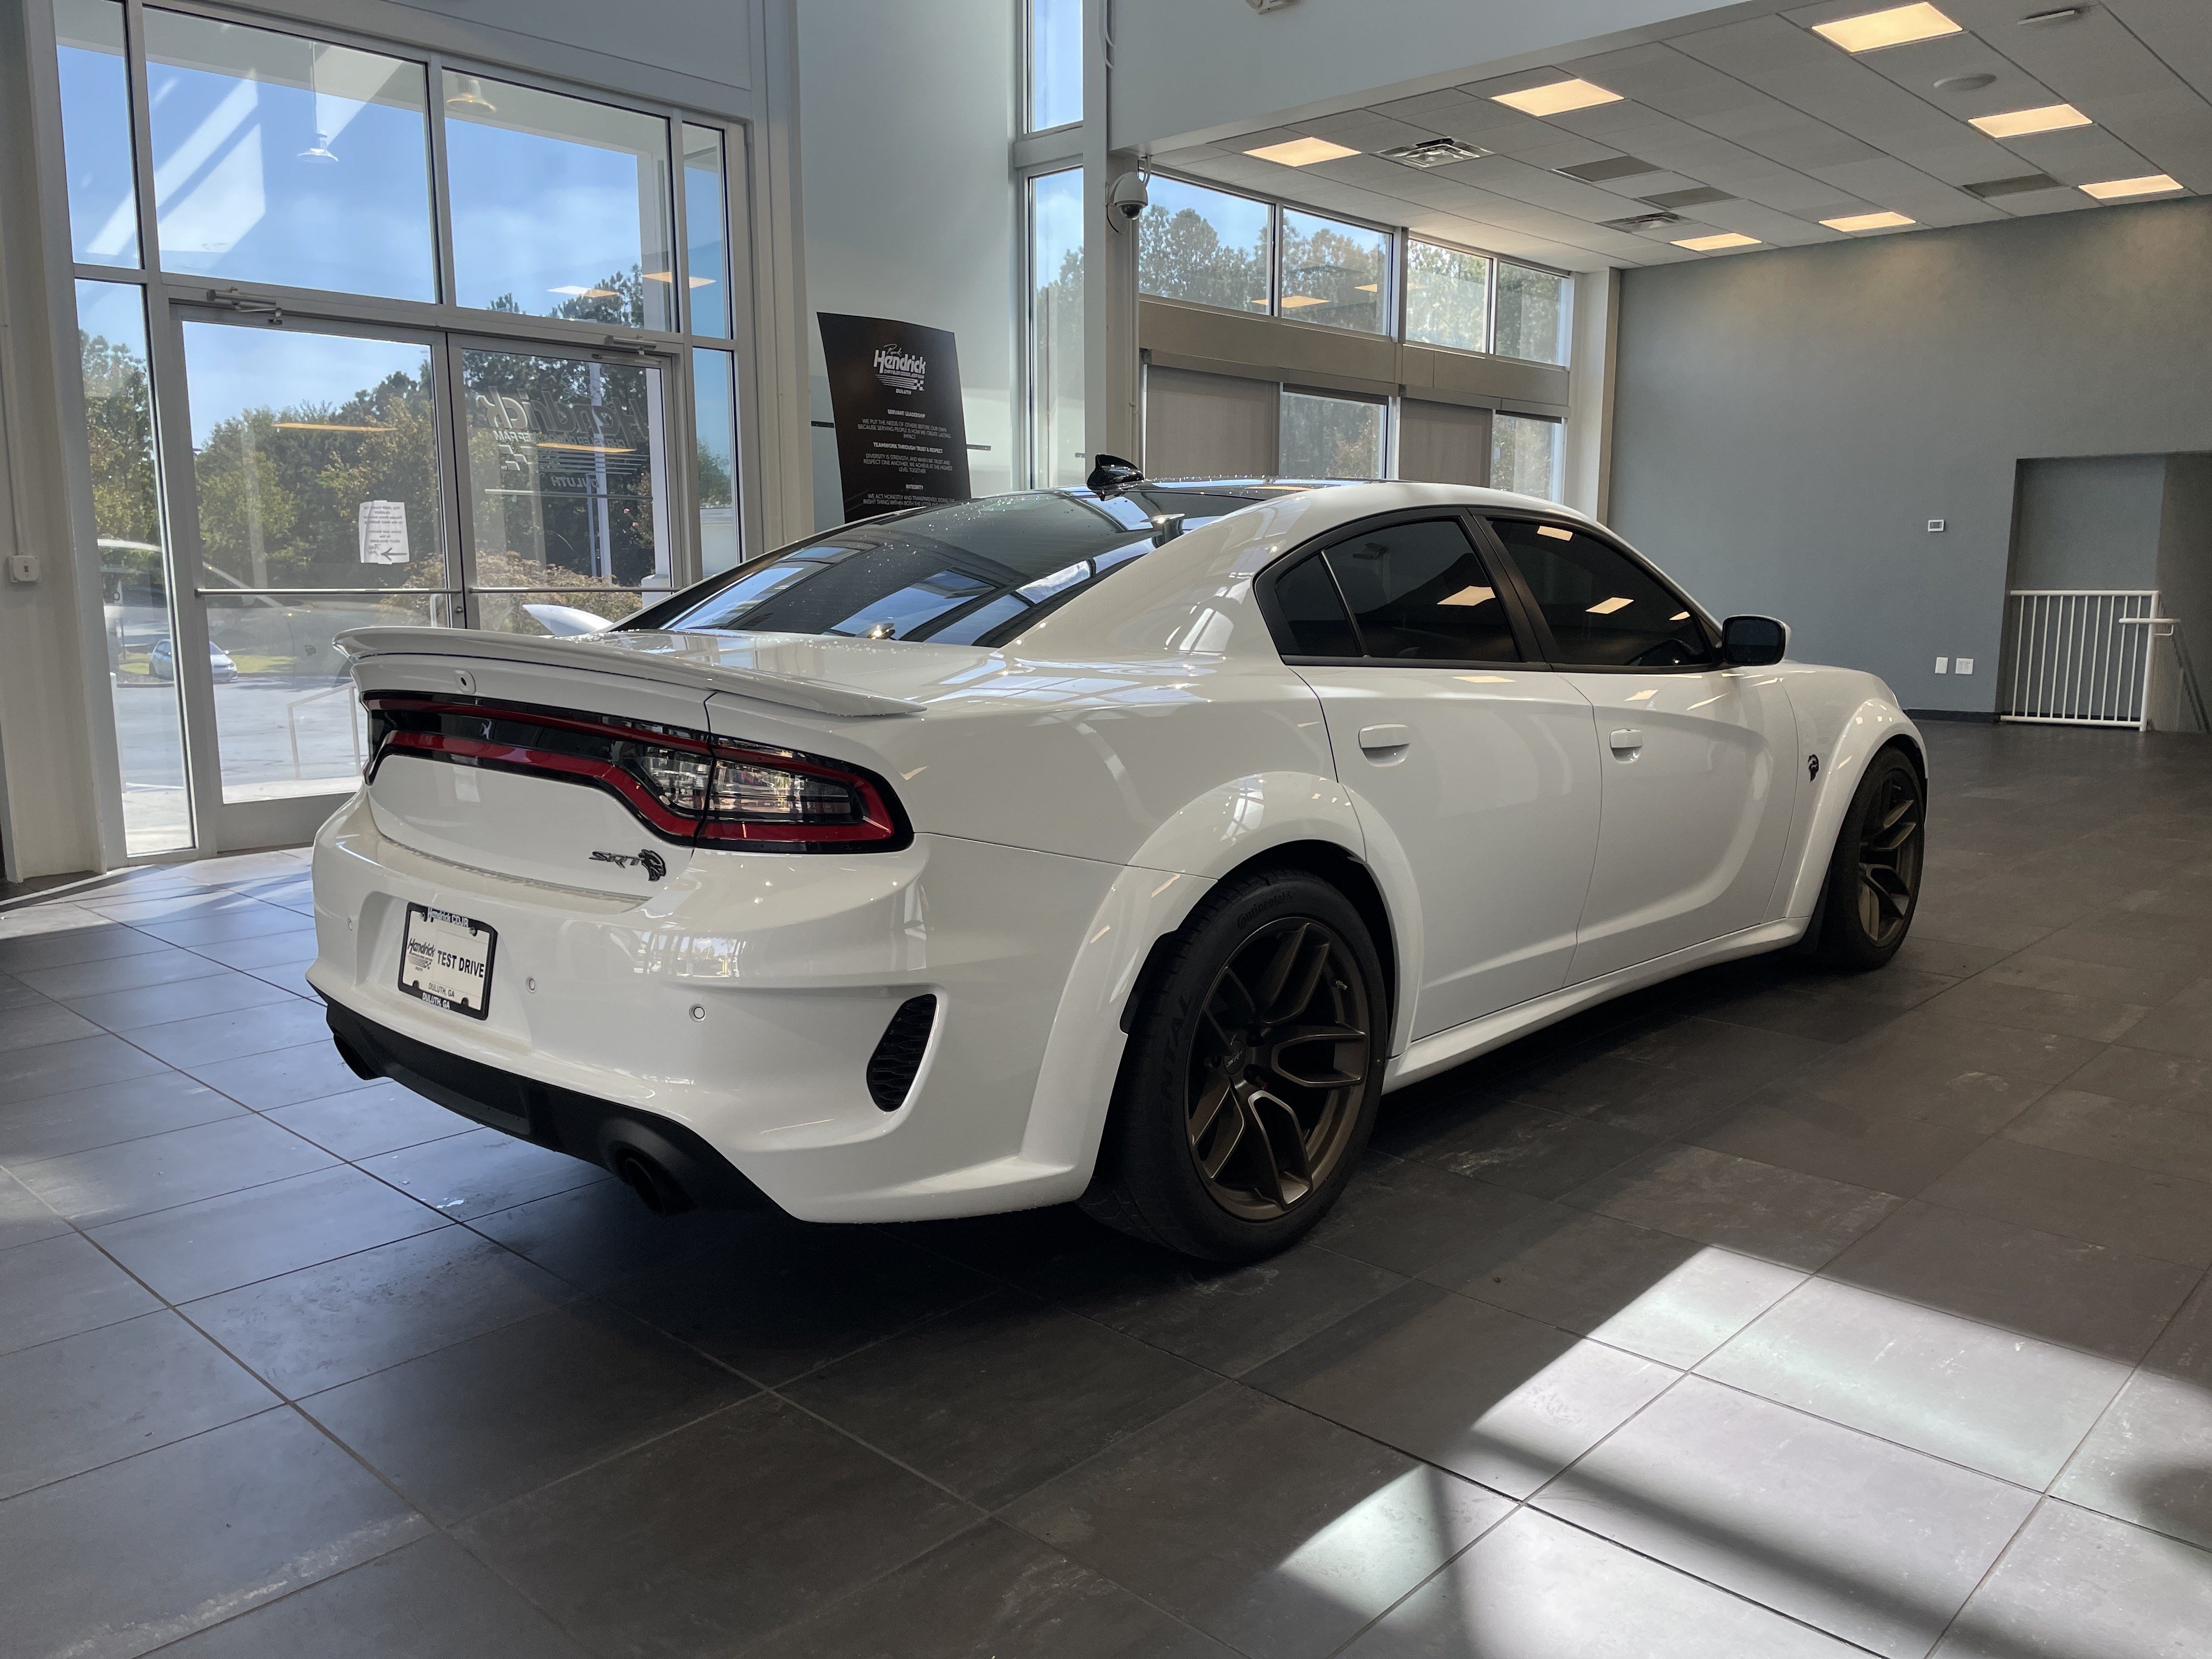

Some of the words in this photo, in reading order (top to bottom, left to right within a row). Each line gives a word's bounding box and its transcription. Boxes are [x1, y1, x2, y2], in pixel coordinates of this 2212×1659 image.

[873, 349, 926, 374] Hendrick
[588, 851, 641, 868] SRT
[428, 907, 450, 922] Hendrick
[451, 914, 469, 928] CDJR
[1237, 891, 1285, 930] Continental
[407, 938, 436, 957] Hendrick
[437, 950, 458, 969] TEST
[459, 957, 484, 978] DRIVE
[428, 982, 447, 996] DULUTH,
[448, 989, 455, 998] GA
[422, 992, 442, 1007] DULUTH,
[442, 1000, 450, 1009] GA
